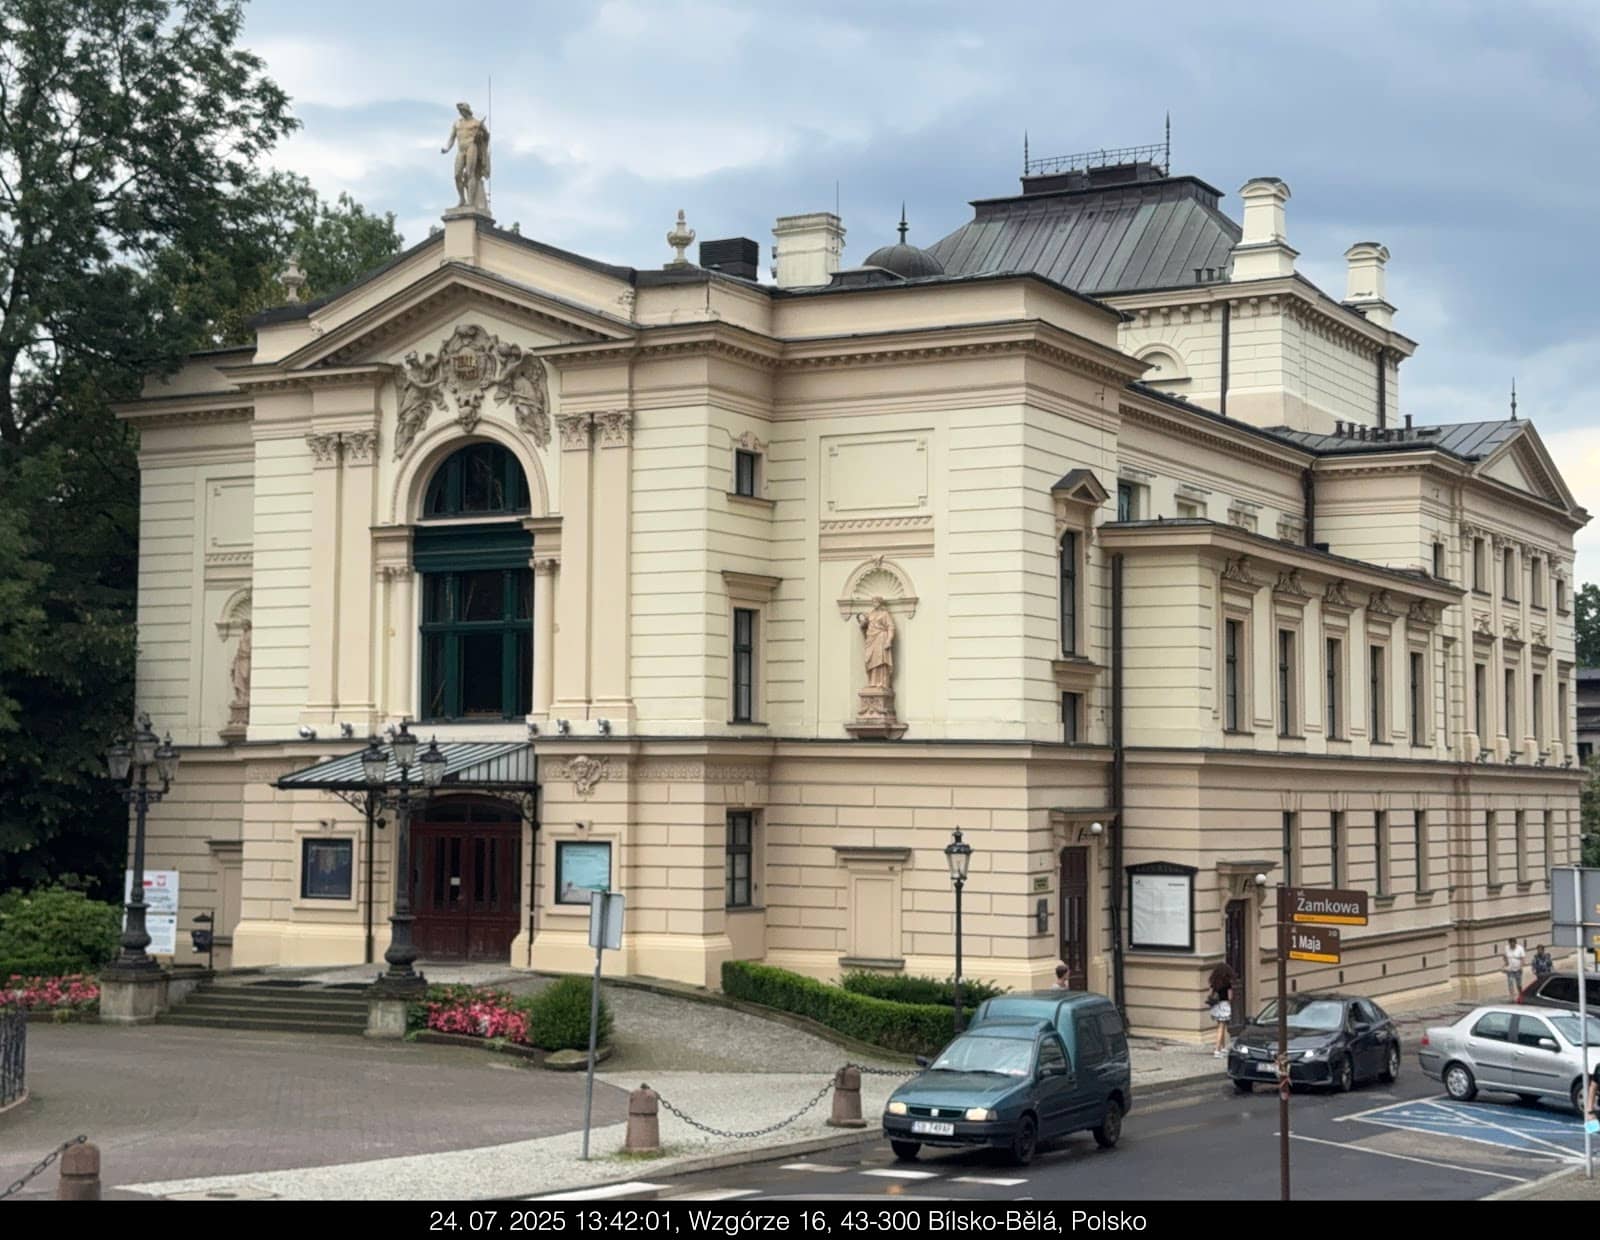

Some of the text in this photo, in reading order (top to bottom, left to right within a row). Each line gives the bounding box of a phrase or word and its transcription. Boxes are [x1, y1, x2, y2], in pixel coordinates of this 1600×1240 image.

[1297, 897, 1360, 914] Zamkowa
[1291, 935, 1321, 953] 1 Maja
